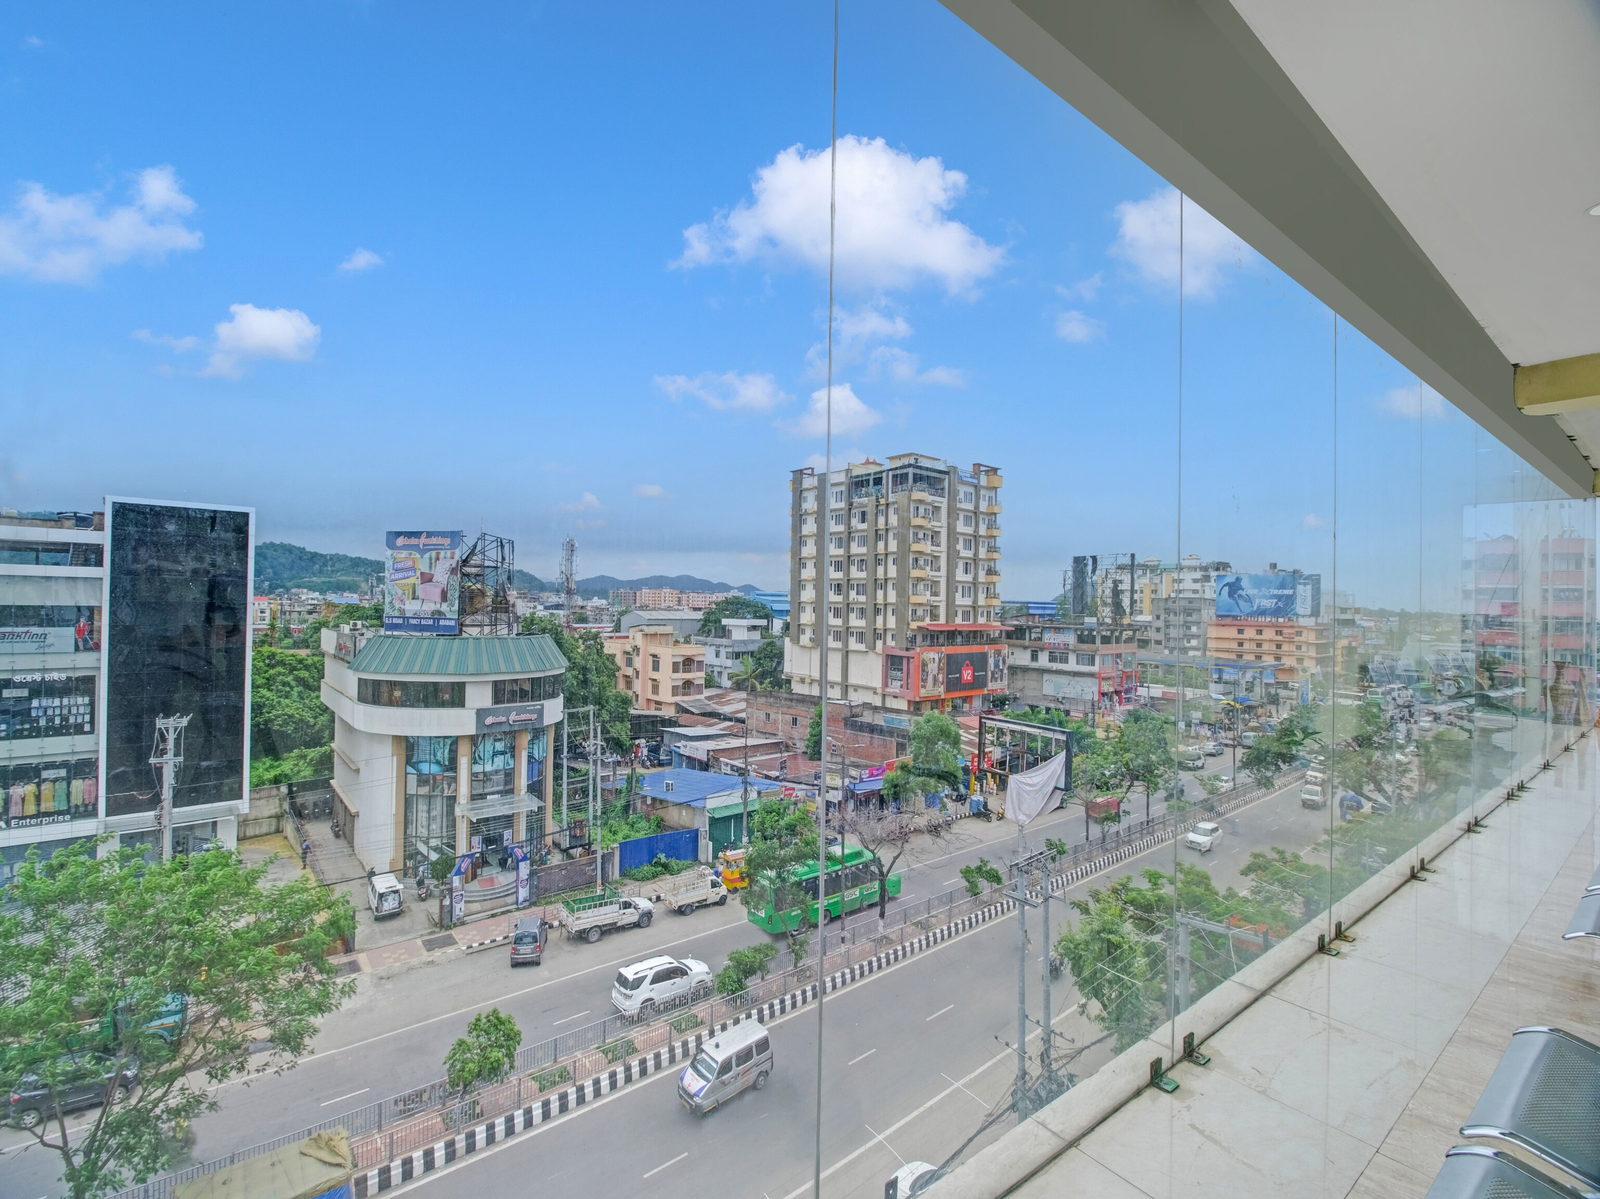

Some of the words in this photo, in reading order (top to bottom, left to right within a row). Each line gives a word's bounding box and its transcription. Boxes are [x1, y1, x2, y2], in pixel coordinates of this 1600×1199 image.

[394, 560, 413, 569] FRESH
[390, 570, 416, 580] ARRIVAL
[963, 670, 972, 680] V2
[11, 814, 71, 828] Enterprise
